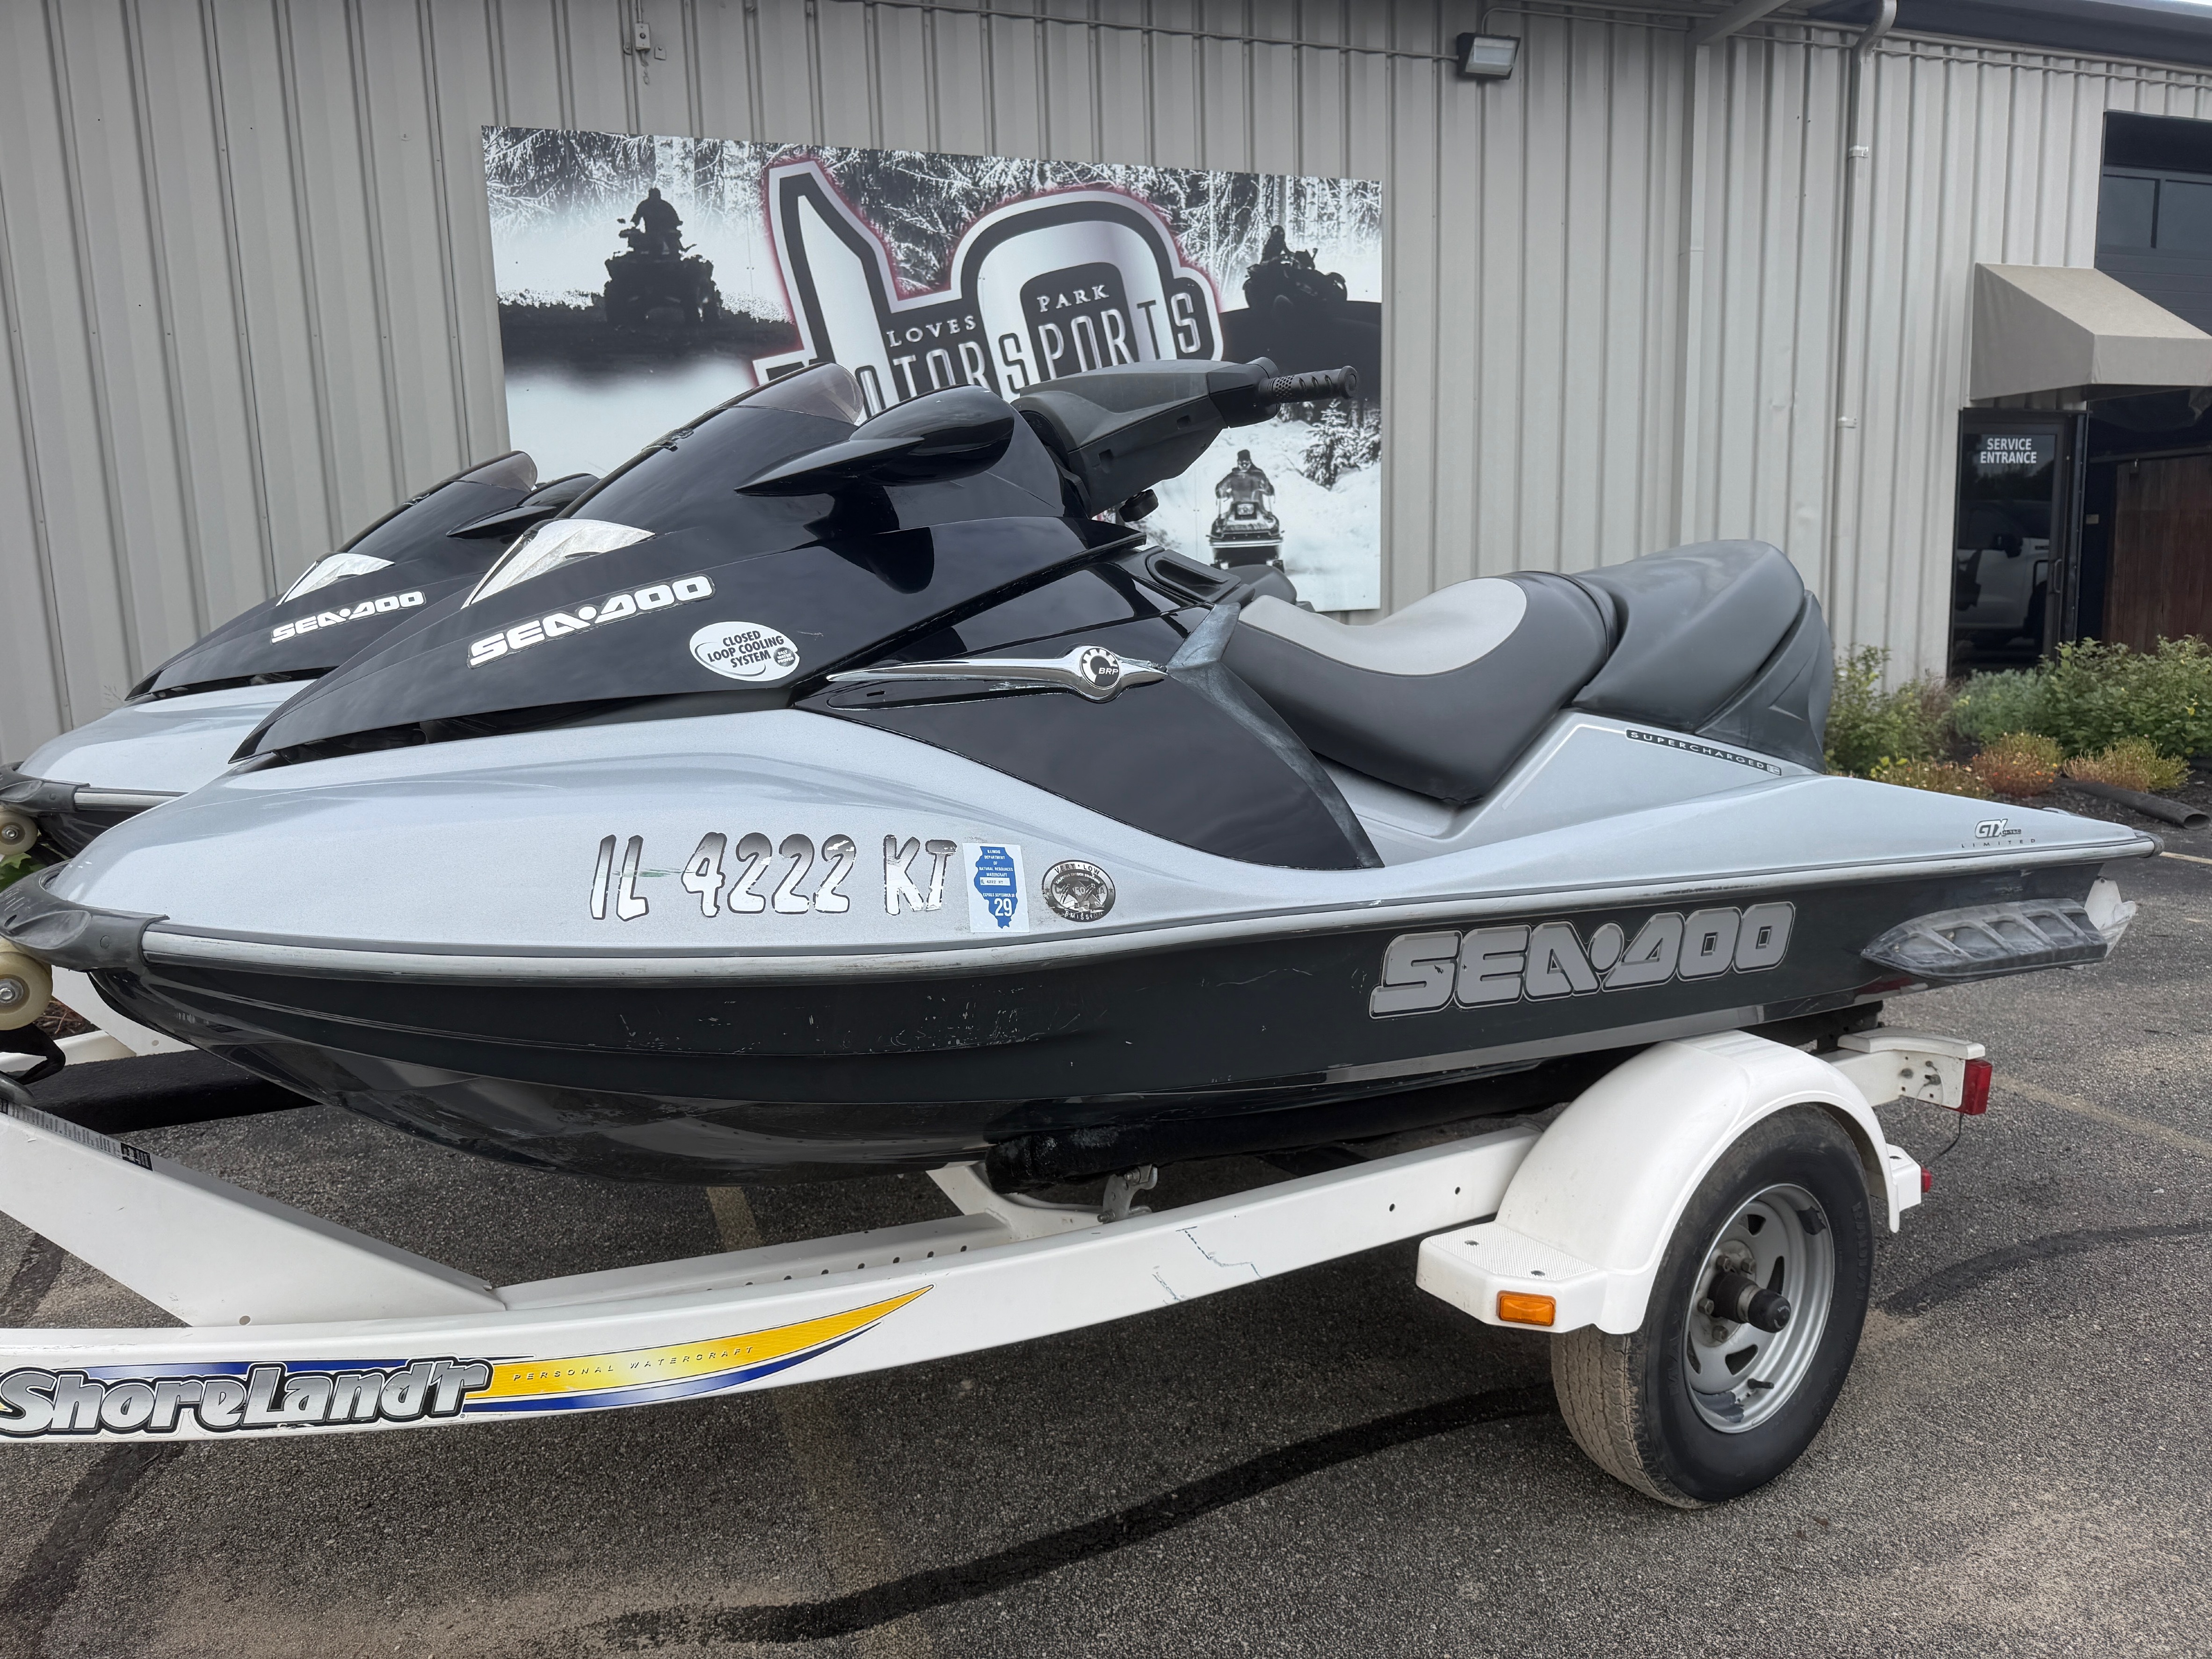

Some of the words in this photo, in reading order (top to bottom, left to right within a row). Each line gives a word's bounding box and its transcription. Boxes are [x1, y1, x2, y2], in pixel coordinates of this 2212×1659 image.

[1036, 284, 1110, 313] PARK
[886, 315, 977, 348] LOVES
[854, 291, 1201, 420] OTORSPORTS
[1987, 438, 2032, 451] SERVICE
[1980, 451, 2037, 464] ENTRANCE
[723, 630, 761, 647] CLOSED
[707, 648, 736, 662] LOOP
[738, 636, 784, 654] COOLING
[730, 650, 771, 668] SYSTEM
[1630, 732, 1764, 768] SUPERCHARGED
[1975, 819, 2008, 838] GTX
[1961, 839, 2036, 848] LIMITED
[589, 834, 649, 922] IL
[681, 832, 857, 918] 4222
[883, 834, 957, 916] KT
[1054, 863, 1075, 874] VERY
[1083, 864, 1100, 875] LOW
[994, 898, 1012, 917] 29
[513, 1365, 614, 1382] PERSONAL
[630, 1346, 754, 1369] WATERCRAFT
